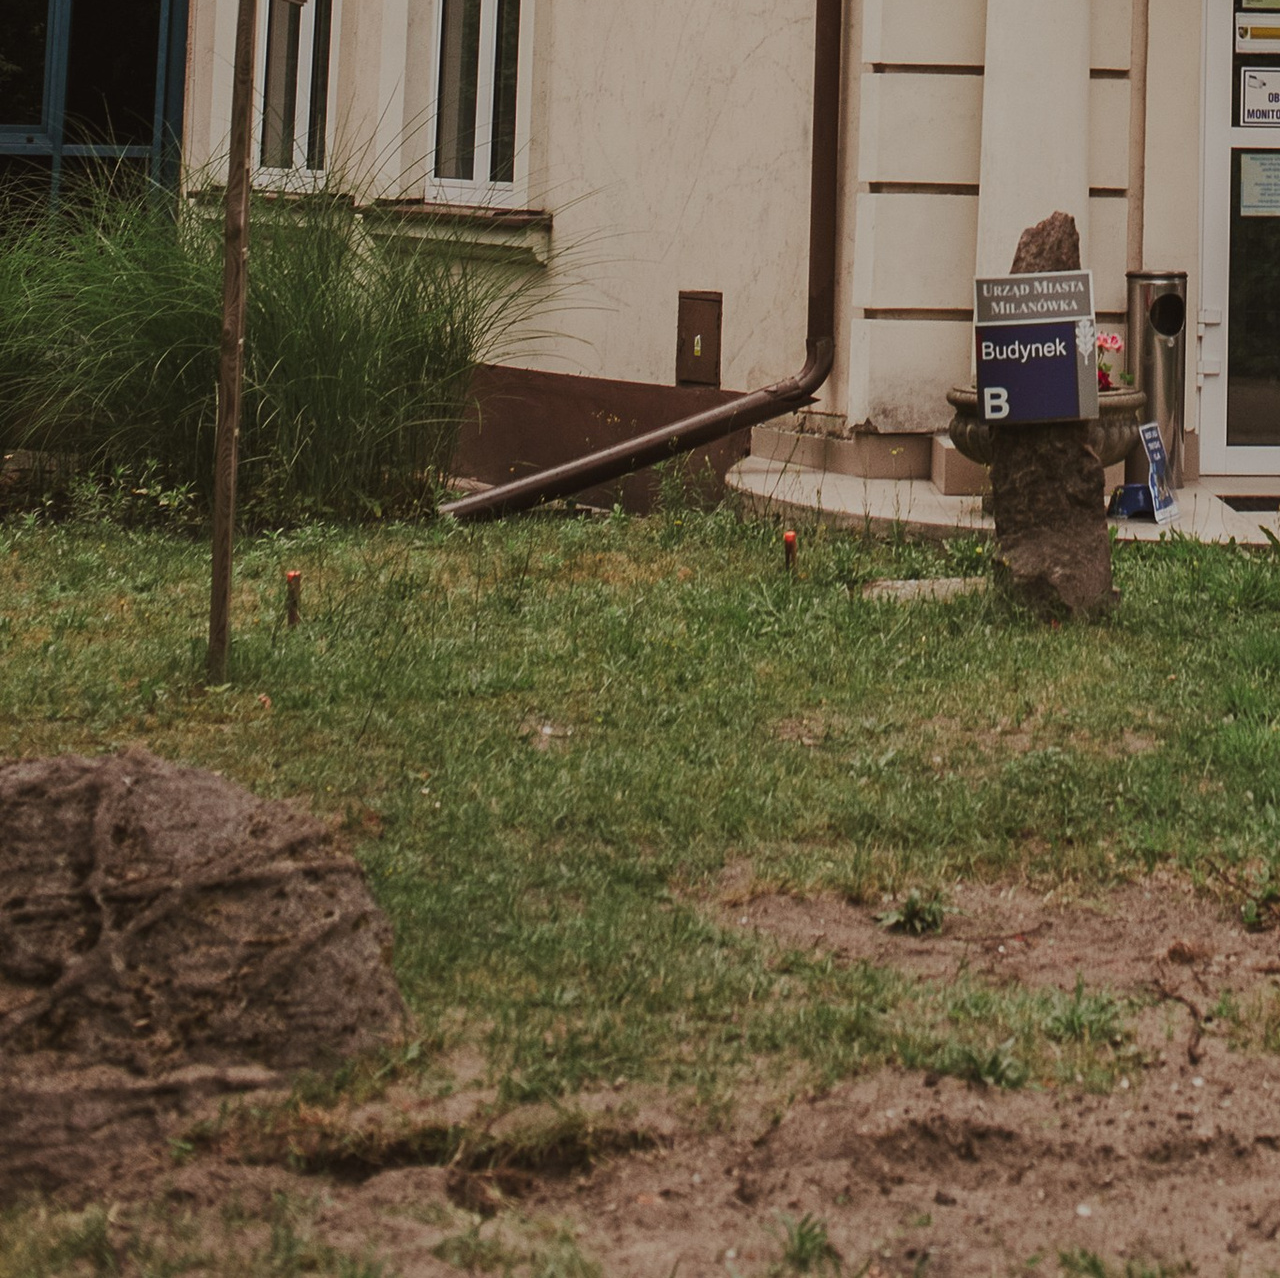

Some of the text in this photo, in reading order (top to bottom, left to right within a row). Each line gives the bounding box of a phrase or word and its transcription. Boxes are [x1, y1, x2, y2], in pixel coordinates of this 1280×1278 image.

[982, 278, 1085, 298] URZĄD MIASTA
[990, 297, 1079, 316] MILANÓWKA
[981, 337, 1067, 363] Budynek
[983, 386, 1010, 420] B
